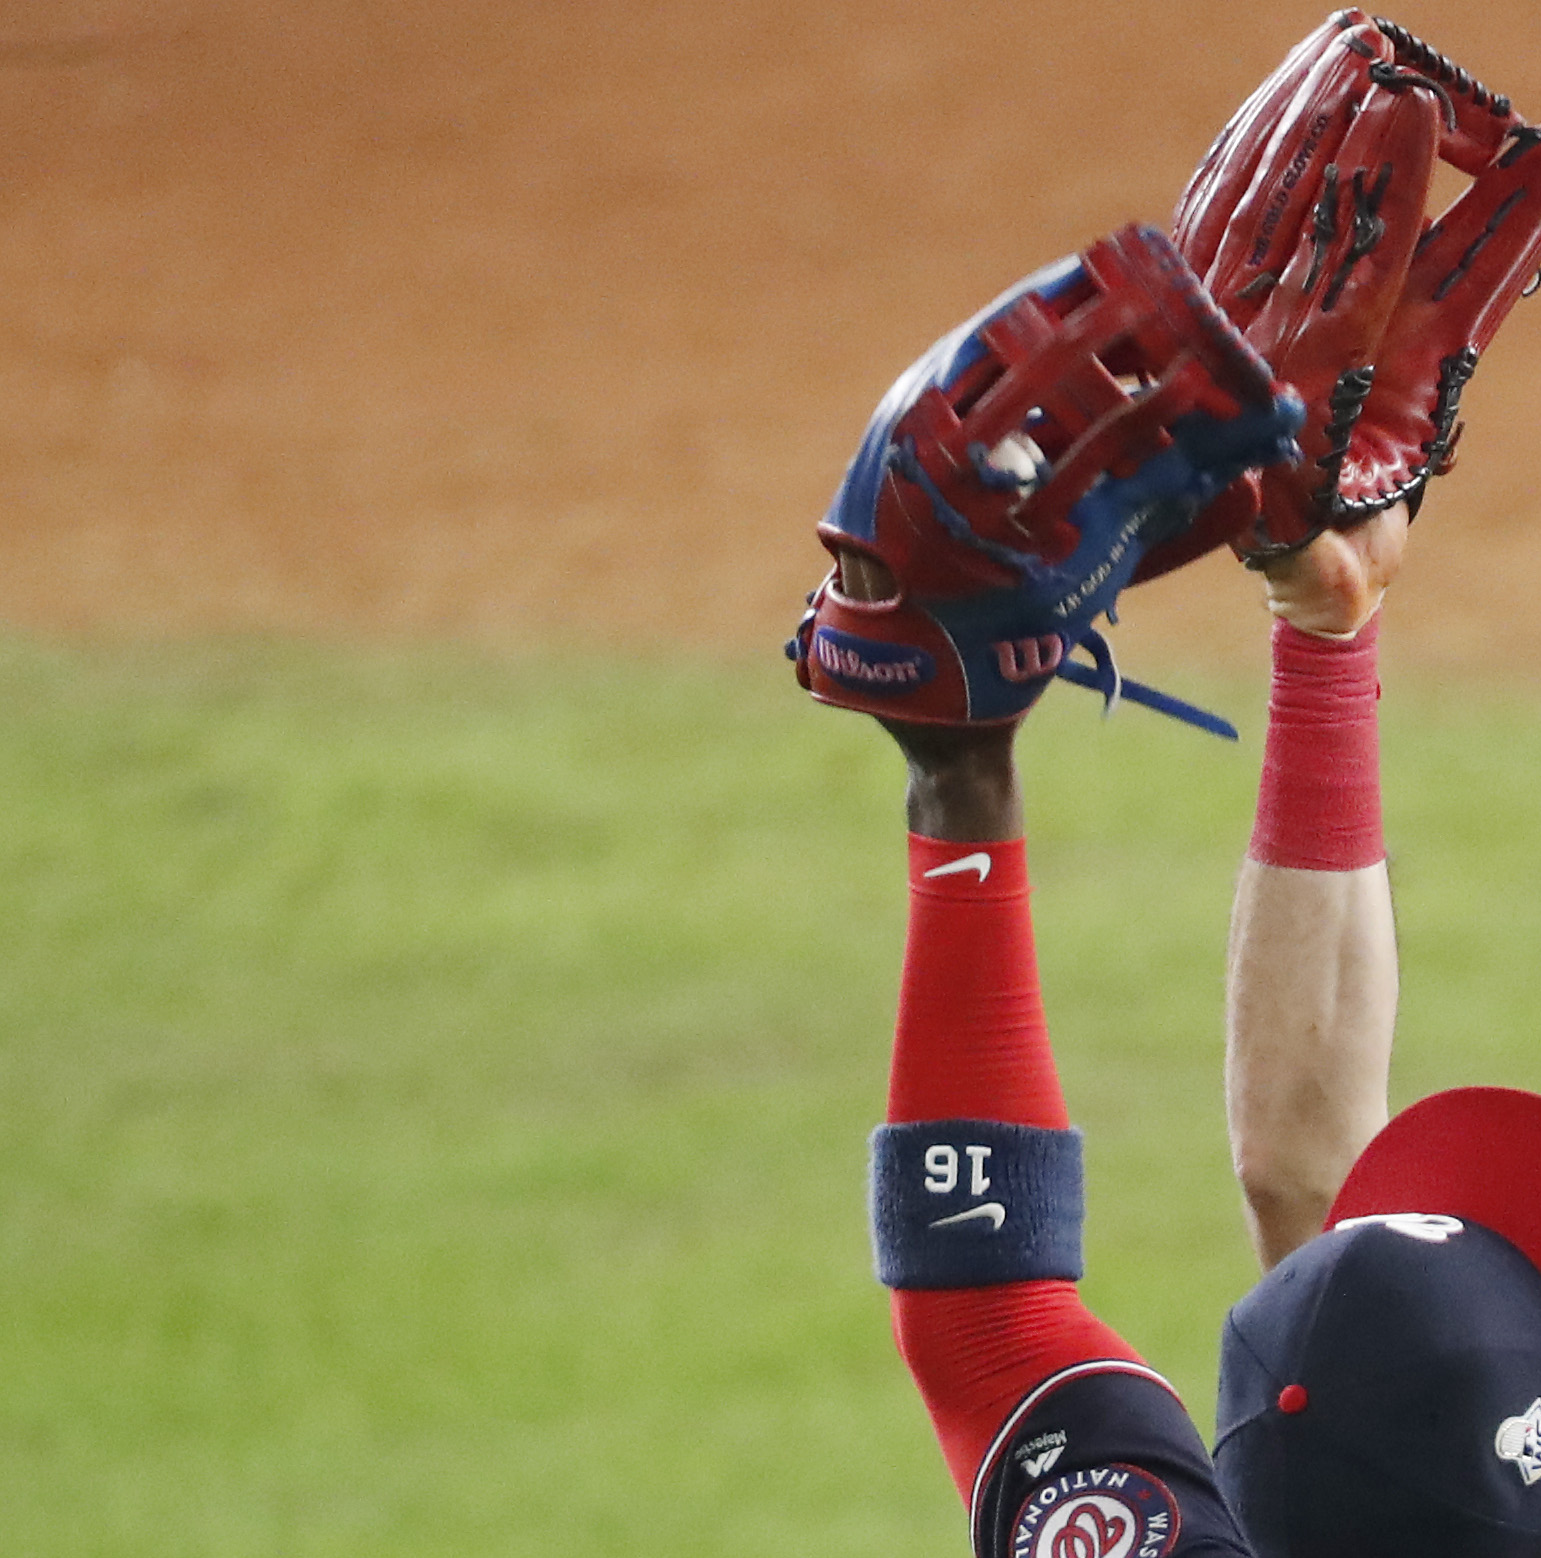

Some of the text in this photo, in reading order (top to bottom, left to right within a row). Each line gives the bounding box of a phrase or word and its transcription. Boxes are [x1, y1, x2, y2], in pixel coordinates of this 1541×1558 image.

[1282, 137, 1317, 190] GLOVE
[816, 634, 919, 684] Wilson
[923, 1143, 993, 1197] 16
